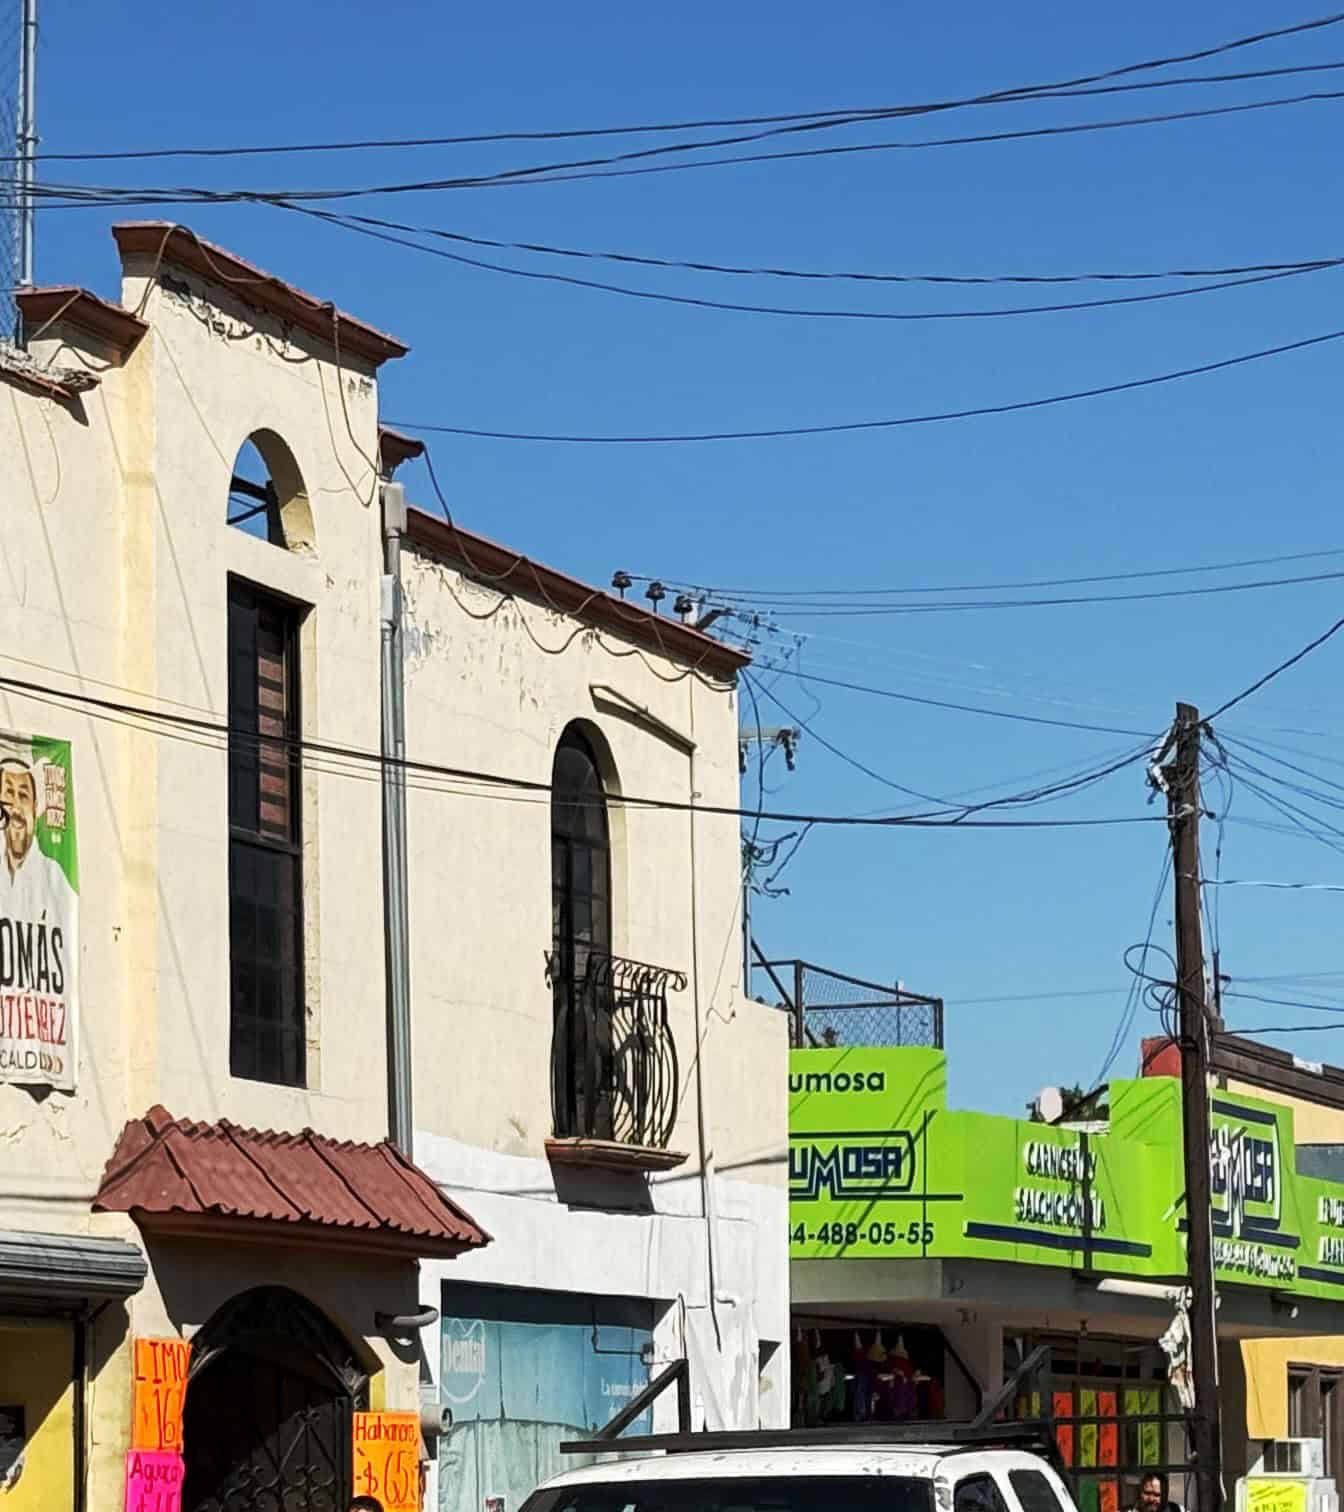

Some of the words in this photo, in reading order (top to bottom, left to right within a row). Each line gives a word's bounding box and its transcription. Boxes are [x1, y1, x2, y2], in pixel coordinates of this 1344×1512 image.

[0, 909, 65, 994] OMÁS
[789, 1071, 885, 1093] umosa
[789, 1143, 902, 1197] UMOSA
[789, 1221, 935, 1246] 4-488-05-55
